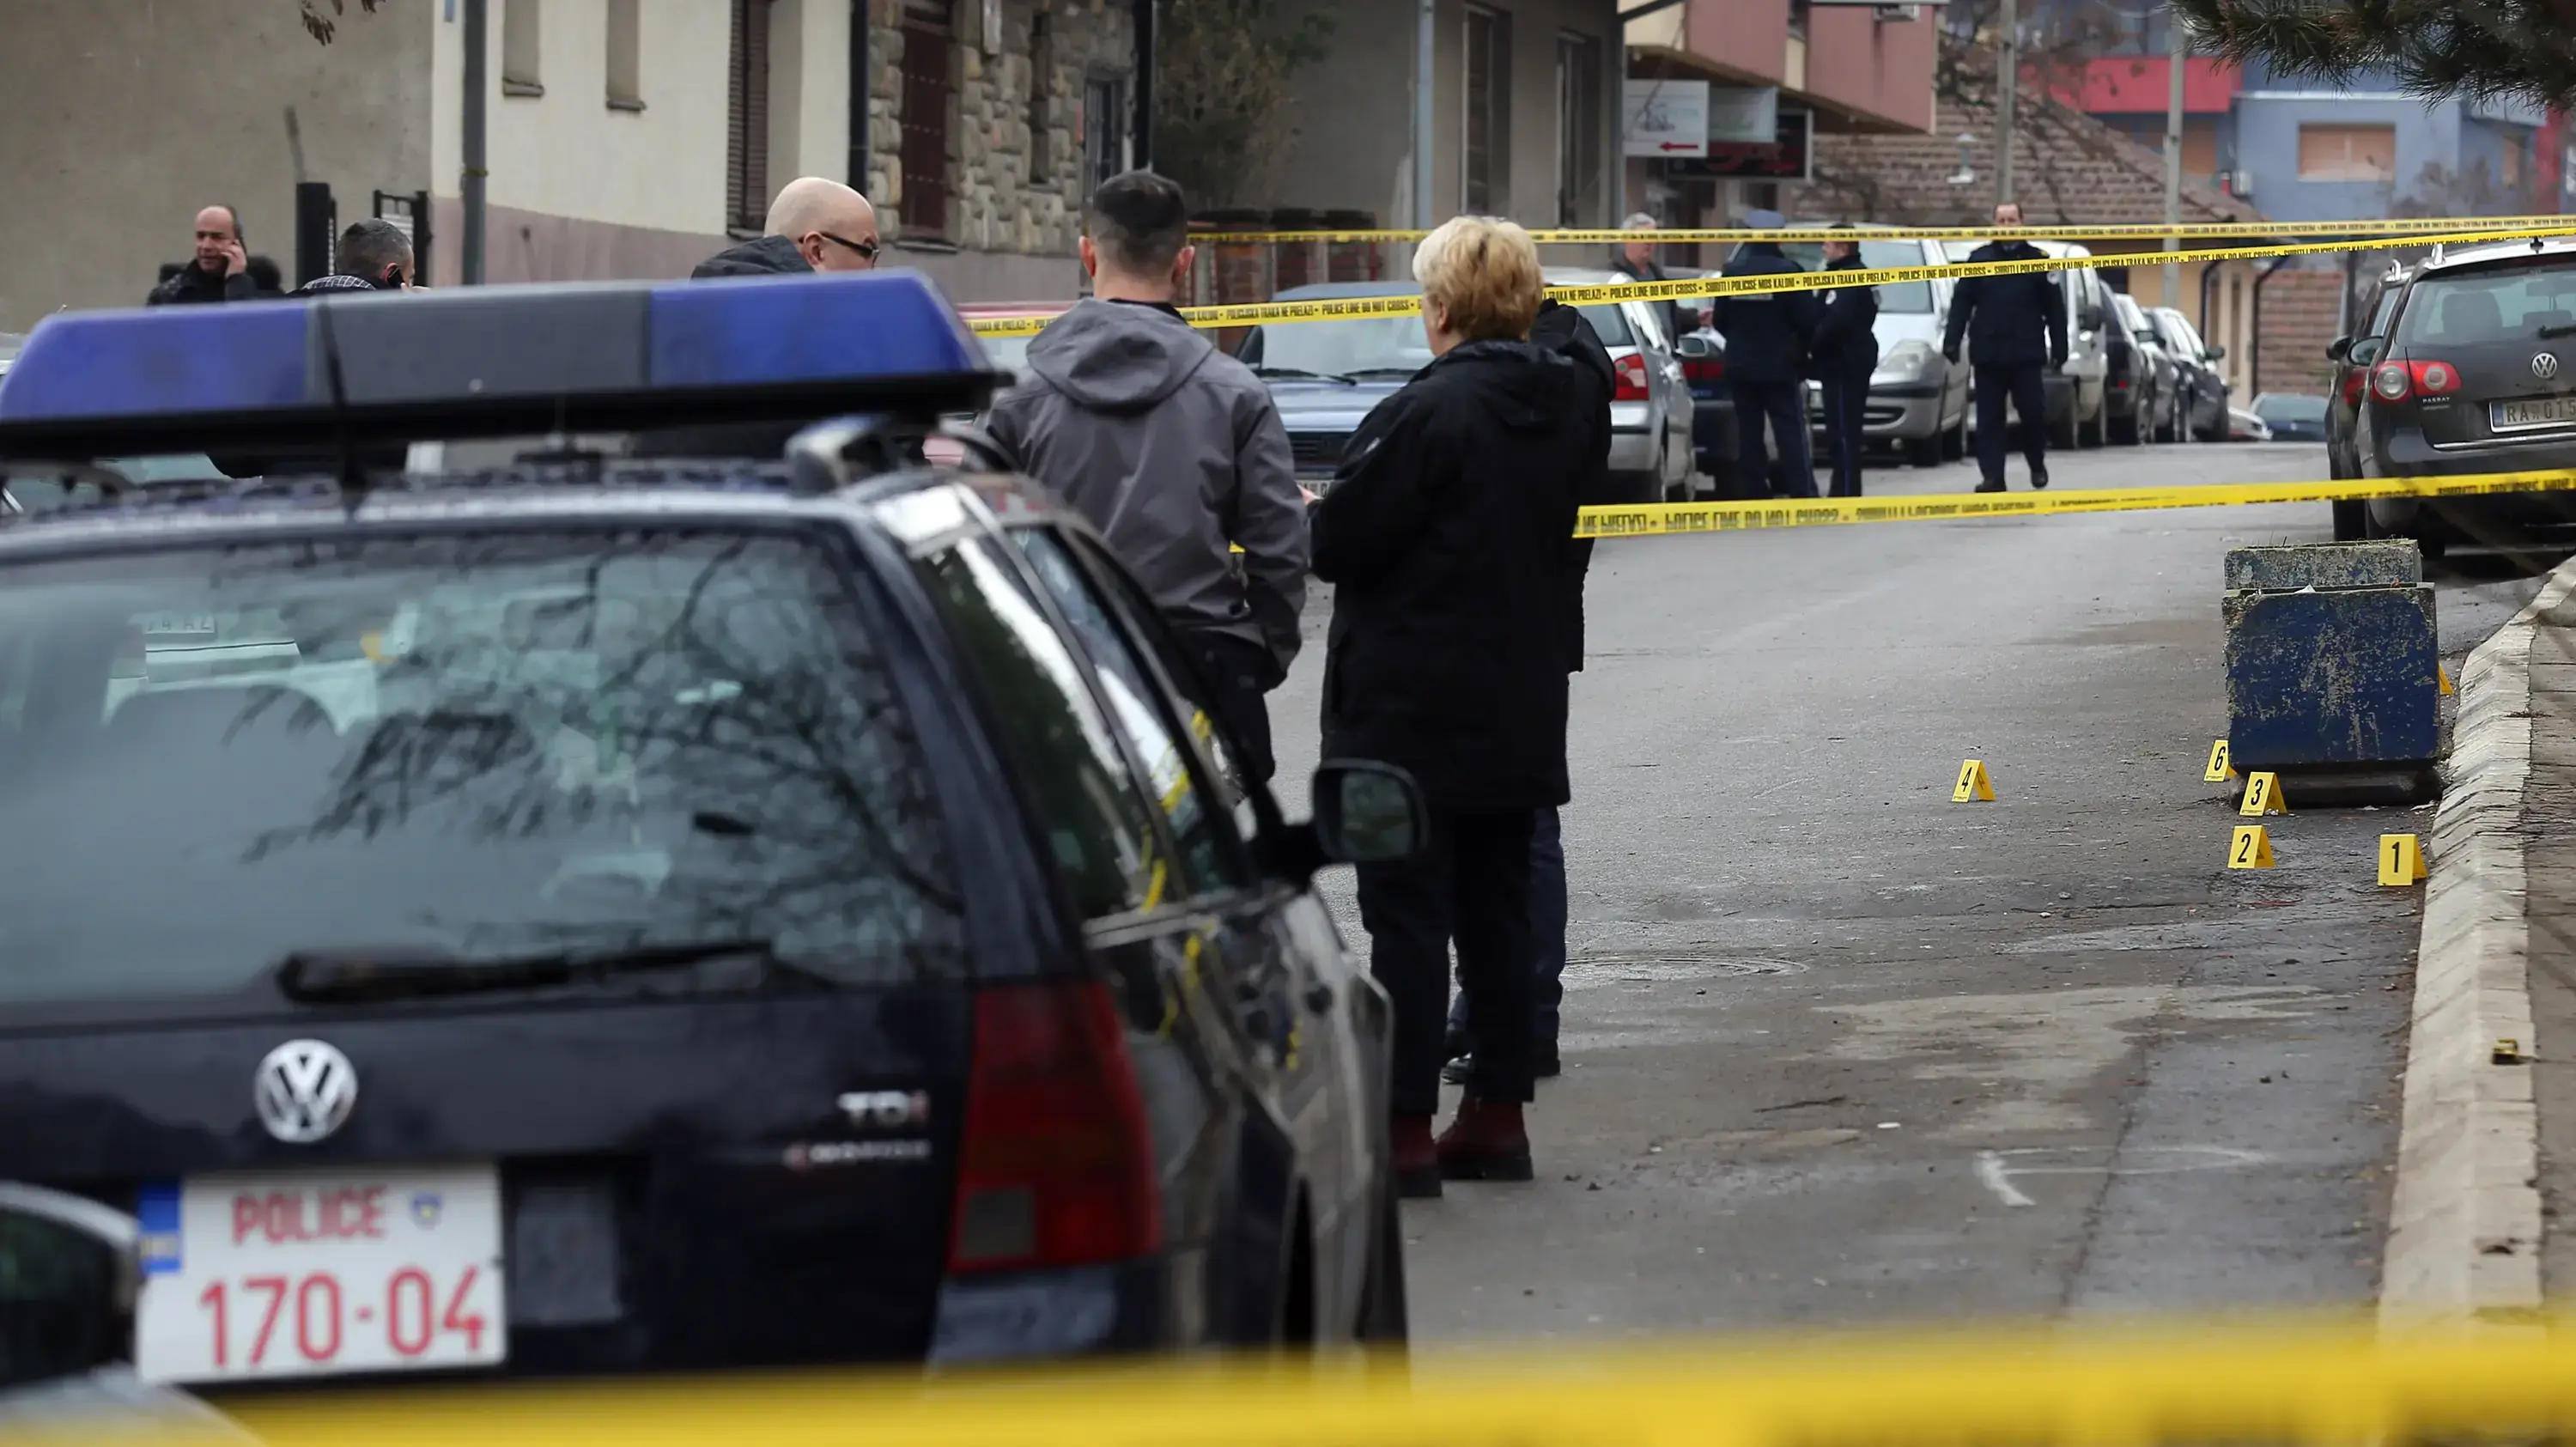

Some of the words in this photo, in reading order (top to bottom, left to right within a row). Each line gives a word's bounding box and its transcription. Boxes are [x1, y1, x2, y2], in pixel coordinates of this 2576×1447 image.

[1610, 286, 1632, 299] POLICE
[1634, 285, 1649, 297] LINE
[1649, 284, 1659, 296] DO
[1661, 283, 1674, 295] NOT
[1675, 283, 1698, 295] CROSS
[1803, 276, 1835, 287] POLICIJSKA
[1837, 274, 1856, 285] TRAKA
[1857, 273, 1865, 283] NE
[1866, 271, 1889, 283] PRELAZI
[1899, 270, 1921, 281] POLICE
[1923, 269, 1937, 279] LINE
[1939, 268, 1947, 278] DO
[1949, 267, 1962, 277] NOT
[1964, 265, 1986, 277] CROSS
[1322, 303, 1345, 315] POLICE
[1346, 301, 1360, 314] LINE
[1362, 301, 1370, 313] DO
[2506, 404, 2530, 422] RA
[2214, 745, 2227, 771] 6
[1961, 766, 1973, 793] 4
[2250, 778, 2263, 806] 3
[2237, 833, 2251, 863] 2
[2391, 841, 2400, 873] 1
[232, 1184, 389, 1246] POLICE
